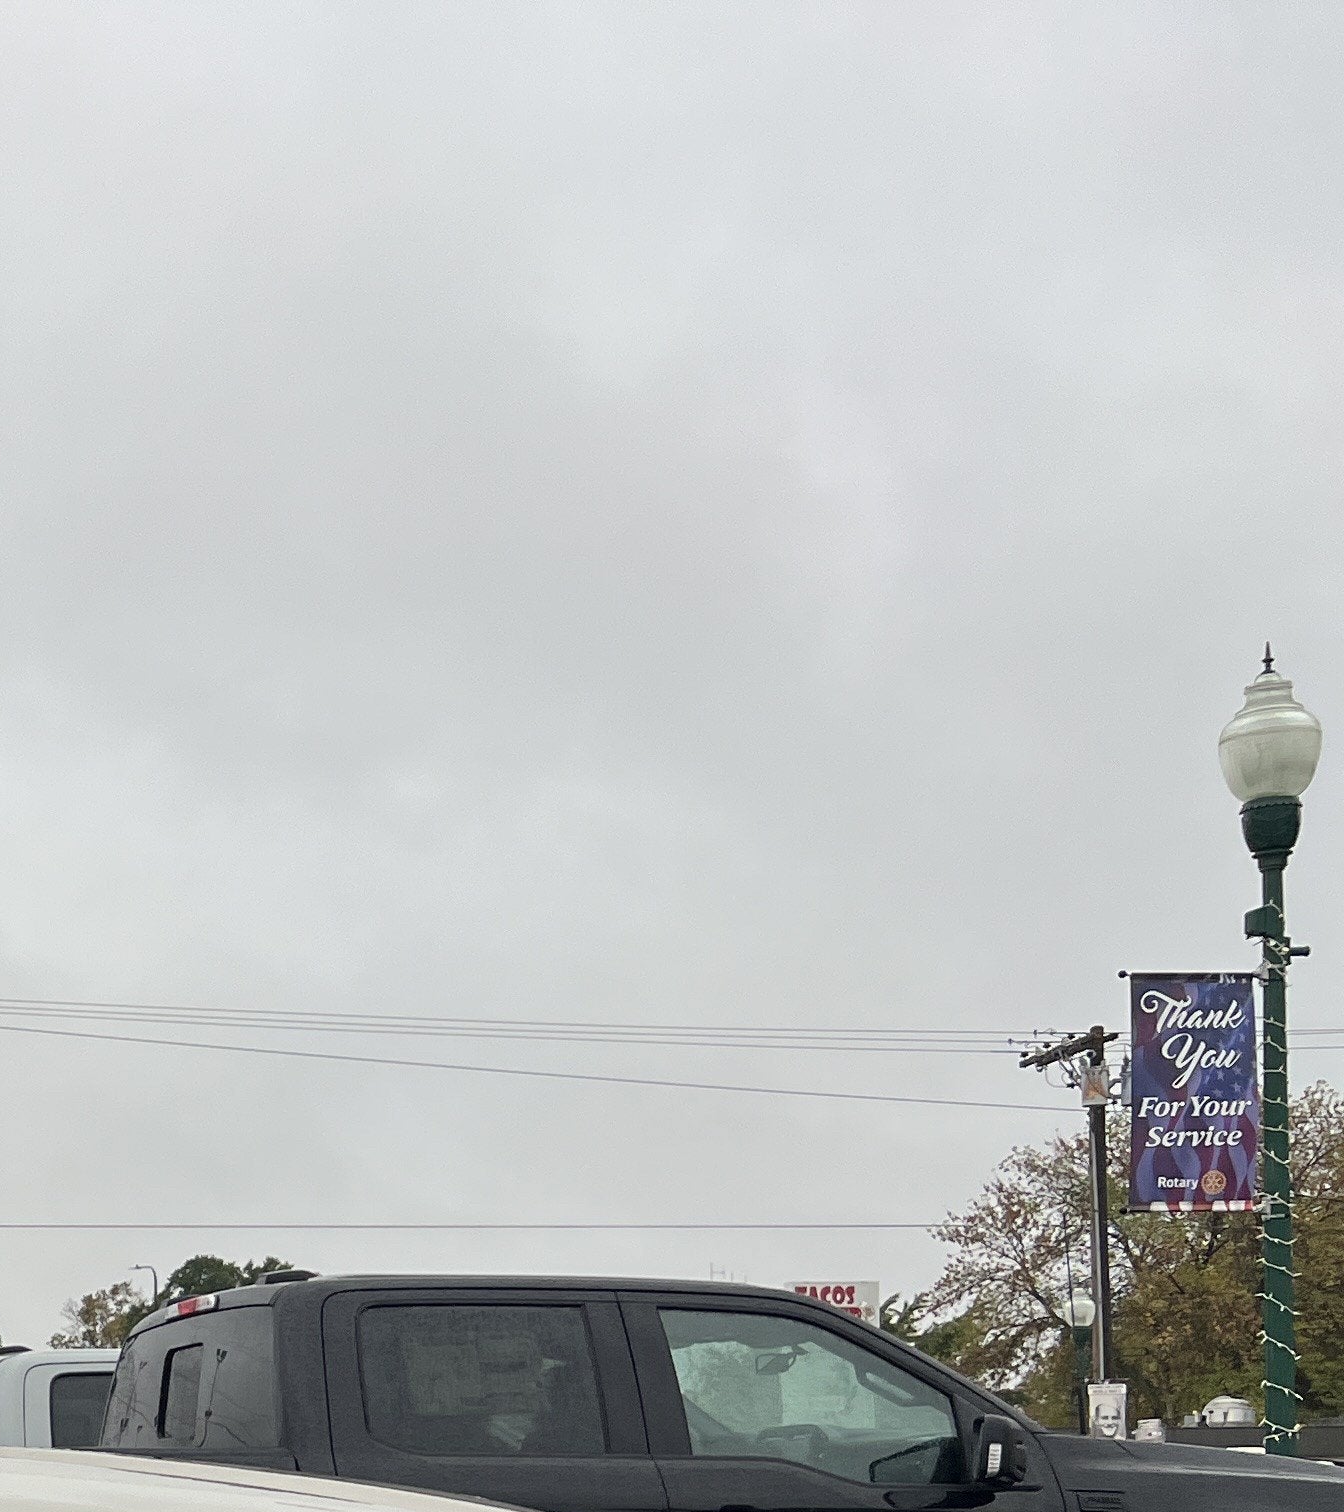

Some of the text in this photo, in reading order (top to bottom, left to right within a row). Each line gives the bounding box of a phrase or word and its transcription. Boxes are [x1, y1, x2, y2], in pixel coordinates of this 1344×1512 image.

[1140, 990, 1247, 1039] Thank
[1162, 1033, 1241, 1089] You
[1138, 1097, 1252, 1118] For Your
[1145, 1127, 1243, 1147] Service
[1157, 1176, 1199, 1190] Rotary
[794, 1286, 855, 1304] TACOS
